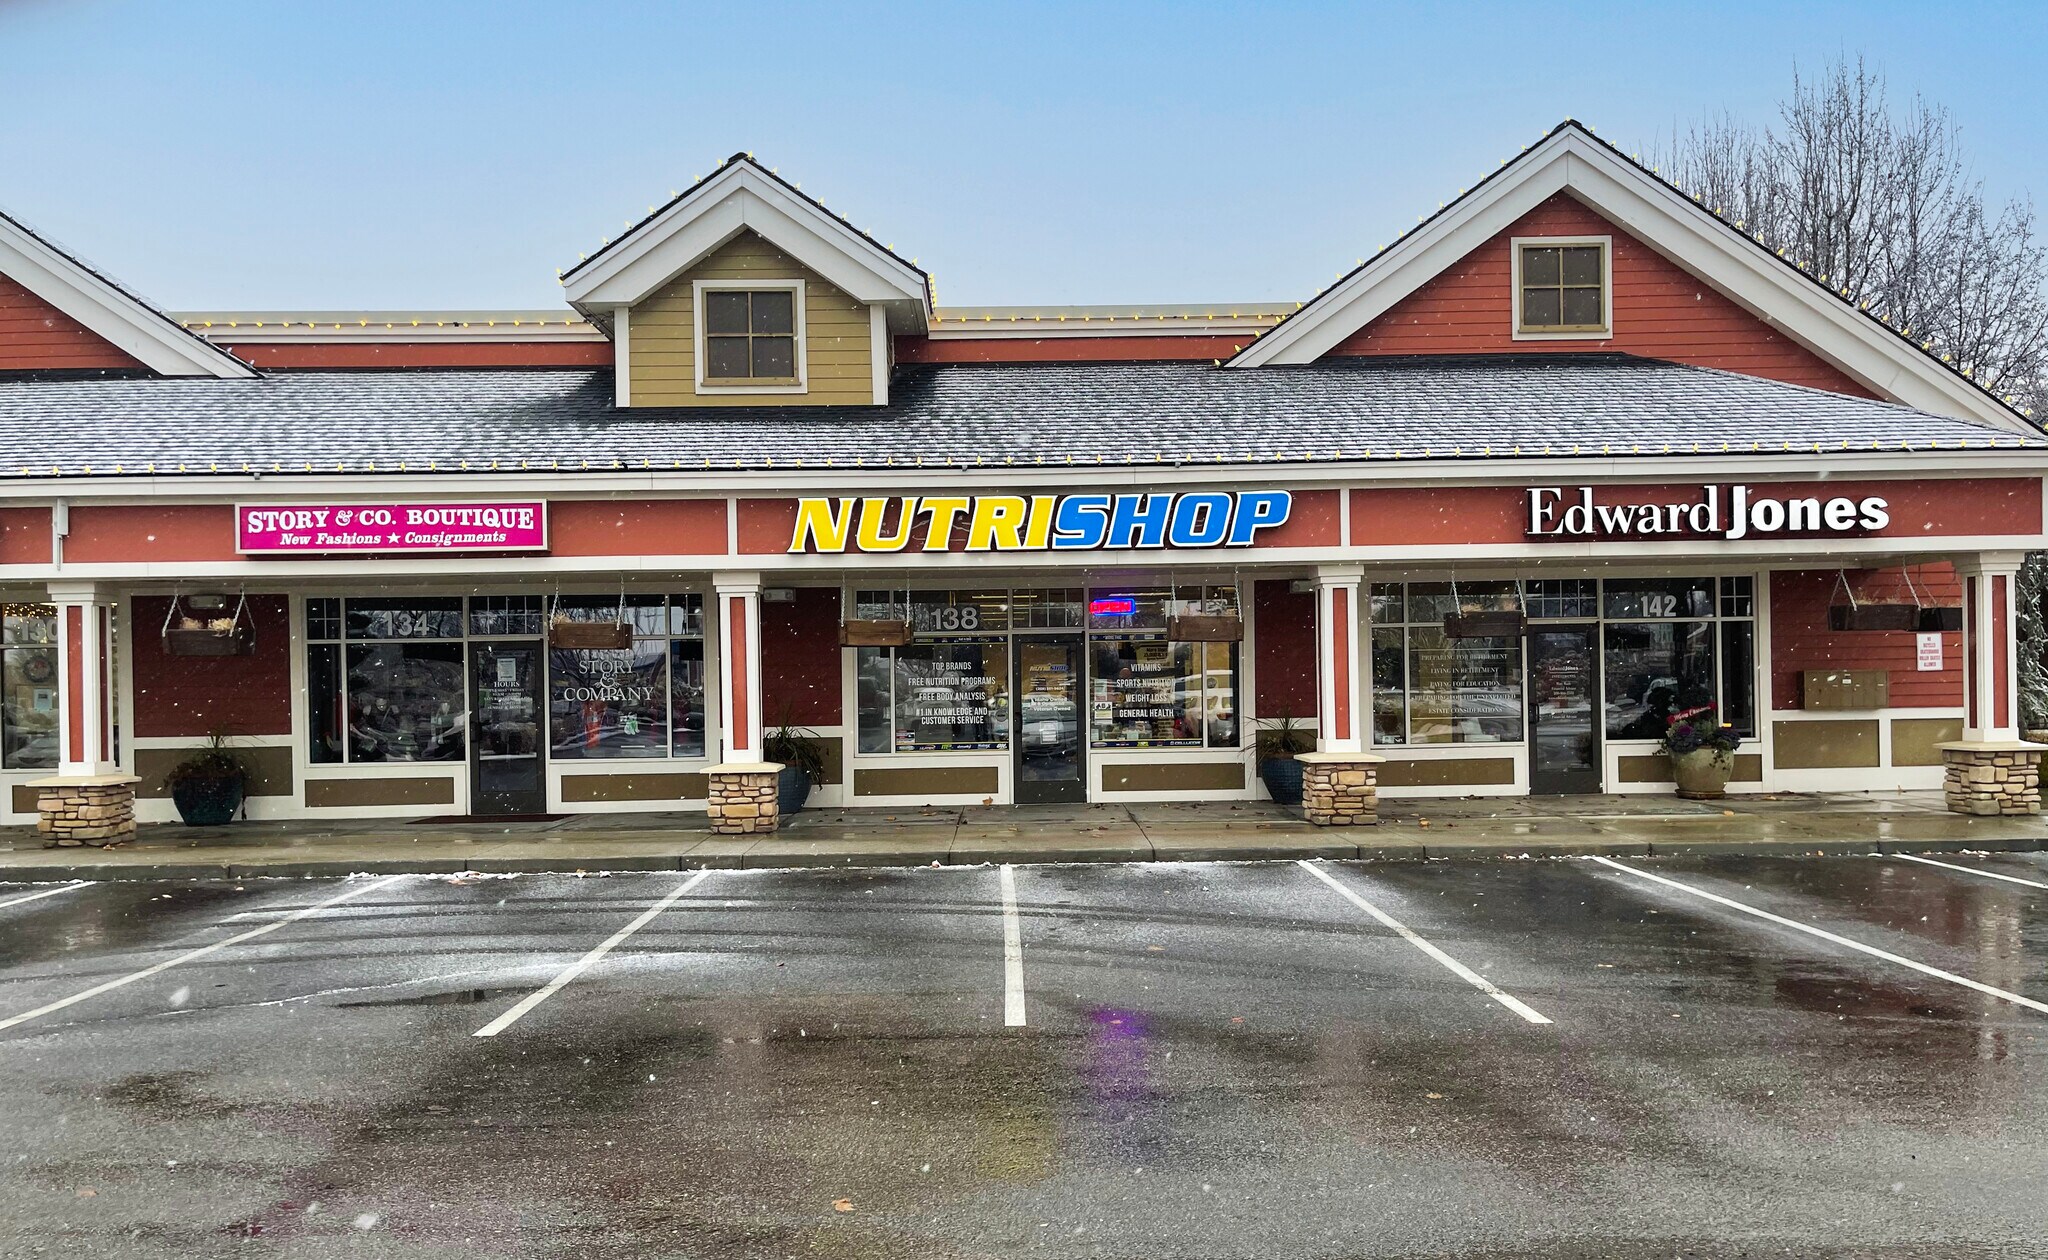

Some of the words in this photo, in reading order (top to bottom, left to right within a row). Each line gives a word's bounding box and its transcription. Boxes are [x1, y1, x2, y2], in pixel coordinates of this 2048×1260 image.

[1526, 485, 1721, 534] Edward
[1726, 485, 1890, 539] Jones
[248, 510, 330, 533] STORY
[335, 510, 352, 526] &
[358, 508, 397, 526] CO.
[406, 508, 534, 530] BOUTIQUE
[787, 490, 1292, 552] NUTRISHOP
[280, 533, 309, 545] New
[315, 532, 381, 545] Fashions
[405, 531, 506, 547] Consignments
[1641, 595, 1677, 617] 142
[381, 610, 430, 636] 134
[931, 607, 978, 630] 138
[579, 660, 635, 675] STORY
[932, 662, 945, 670] TOP
[946, 661, 972, 670] BRANDS
[1131, 663, 1162, 672] VITAMINS
[599, 671, 617, 689] &
[908, 677, 924, 686] FREE
[926, 677, 959, 686] NUTRITION
[961, 676, 996, 685] PROGRAMS
[1116, 679, 1141, 688] SPORTS
[564, 686, 655, 701] COMPANY
[919, 692, 935, 701] FREE
[936, 692, 954, 700] BODY
[955, 691, 986, 700] ANALYSIS
[1125, 694, 1150, 702] WEIGHT
[1152, 693, 1168, 702] LOSS
[925, 708, 932, 716] IN
[933, 707, 973, 716] KNOWLEDGE
[974, 707, 988, 715] AND
[1119, 709, 1148, 718] GENERAL
[1149, 709, 1174, 718] HEALTH
[921, 716, 956, 725] CUSTOMER
[957, 715, 984, 724] SERVICE
